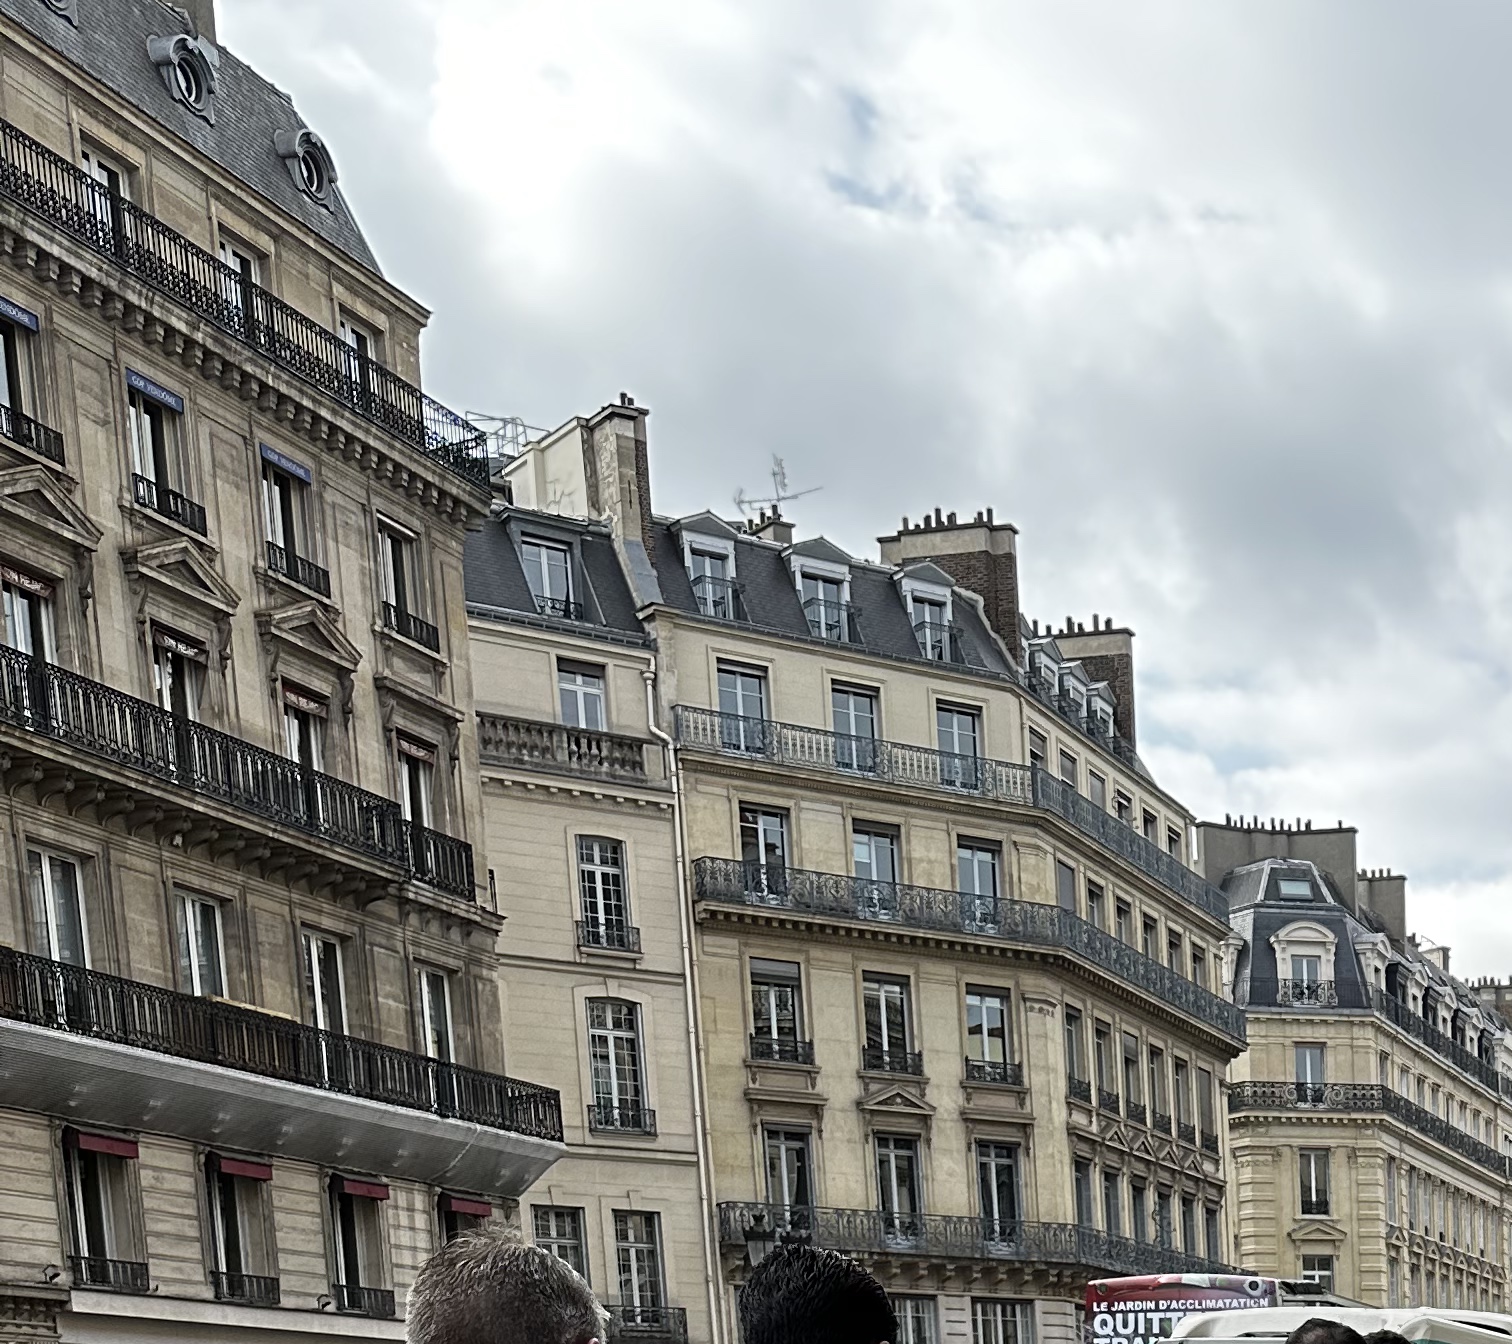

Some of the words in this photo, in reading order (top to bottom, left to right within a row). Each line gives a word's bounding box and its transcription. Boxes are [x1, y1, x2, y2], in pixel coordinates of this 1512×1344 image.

[1093, 1301, 1108, 1312] LE
[1110, 1300, 1156, 1312] JARDIN
[1158, 1298, 1269, 1311] D'ACCLIMATATION
[1093, 1311, 1198, 1336] QUITT
